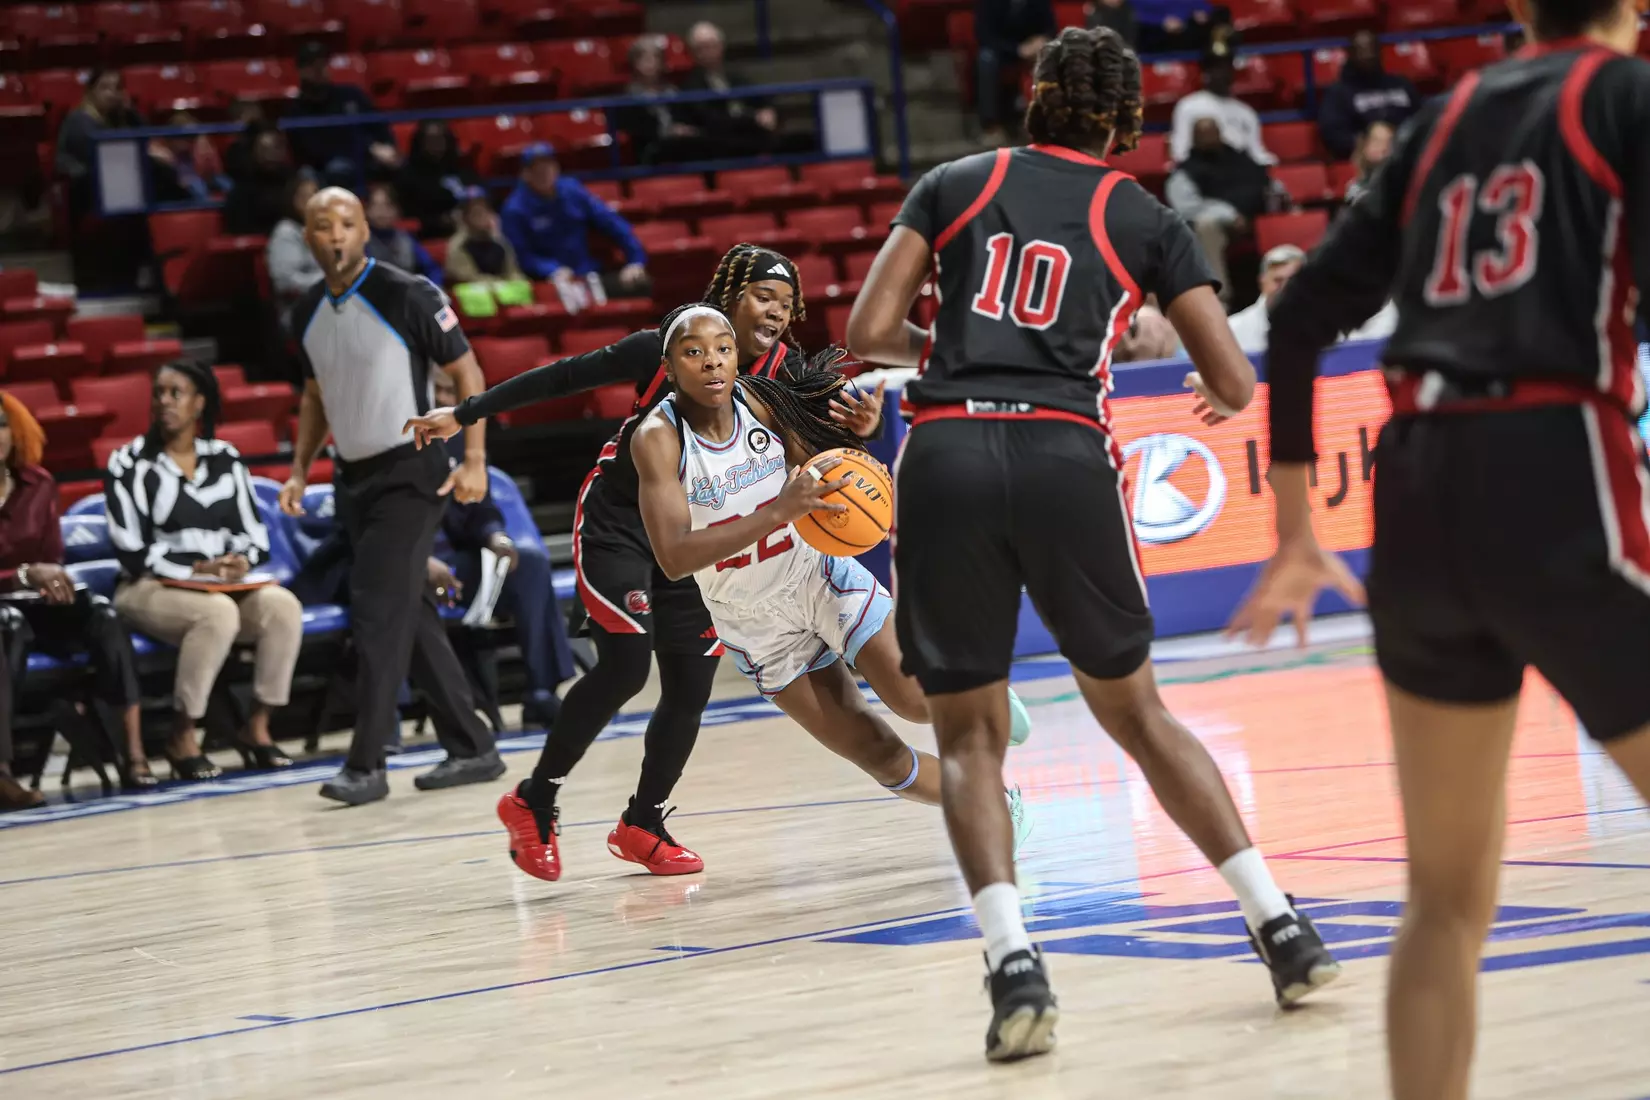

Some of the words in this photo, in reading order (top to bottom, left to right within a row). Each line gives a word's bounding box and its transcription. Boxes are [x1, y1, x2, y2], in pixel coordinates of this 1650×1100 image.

[971, 232, 1072, 330] 10
[1424, 159, 1544, 306] 13
[687, 475, 727, 510] Lady
